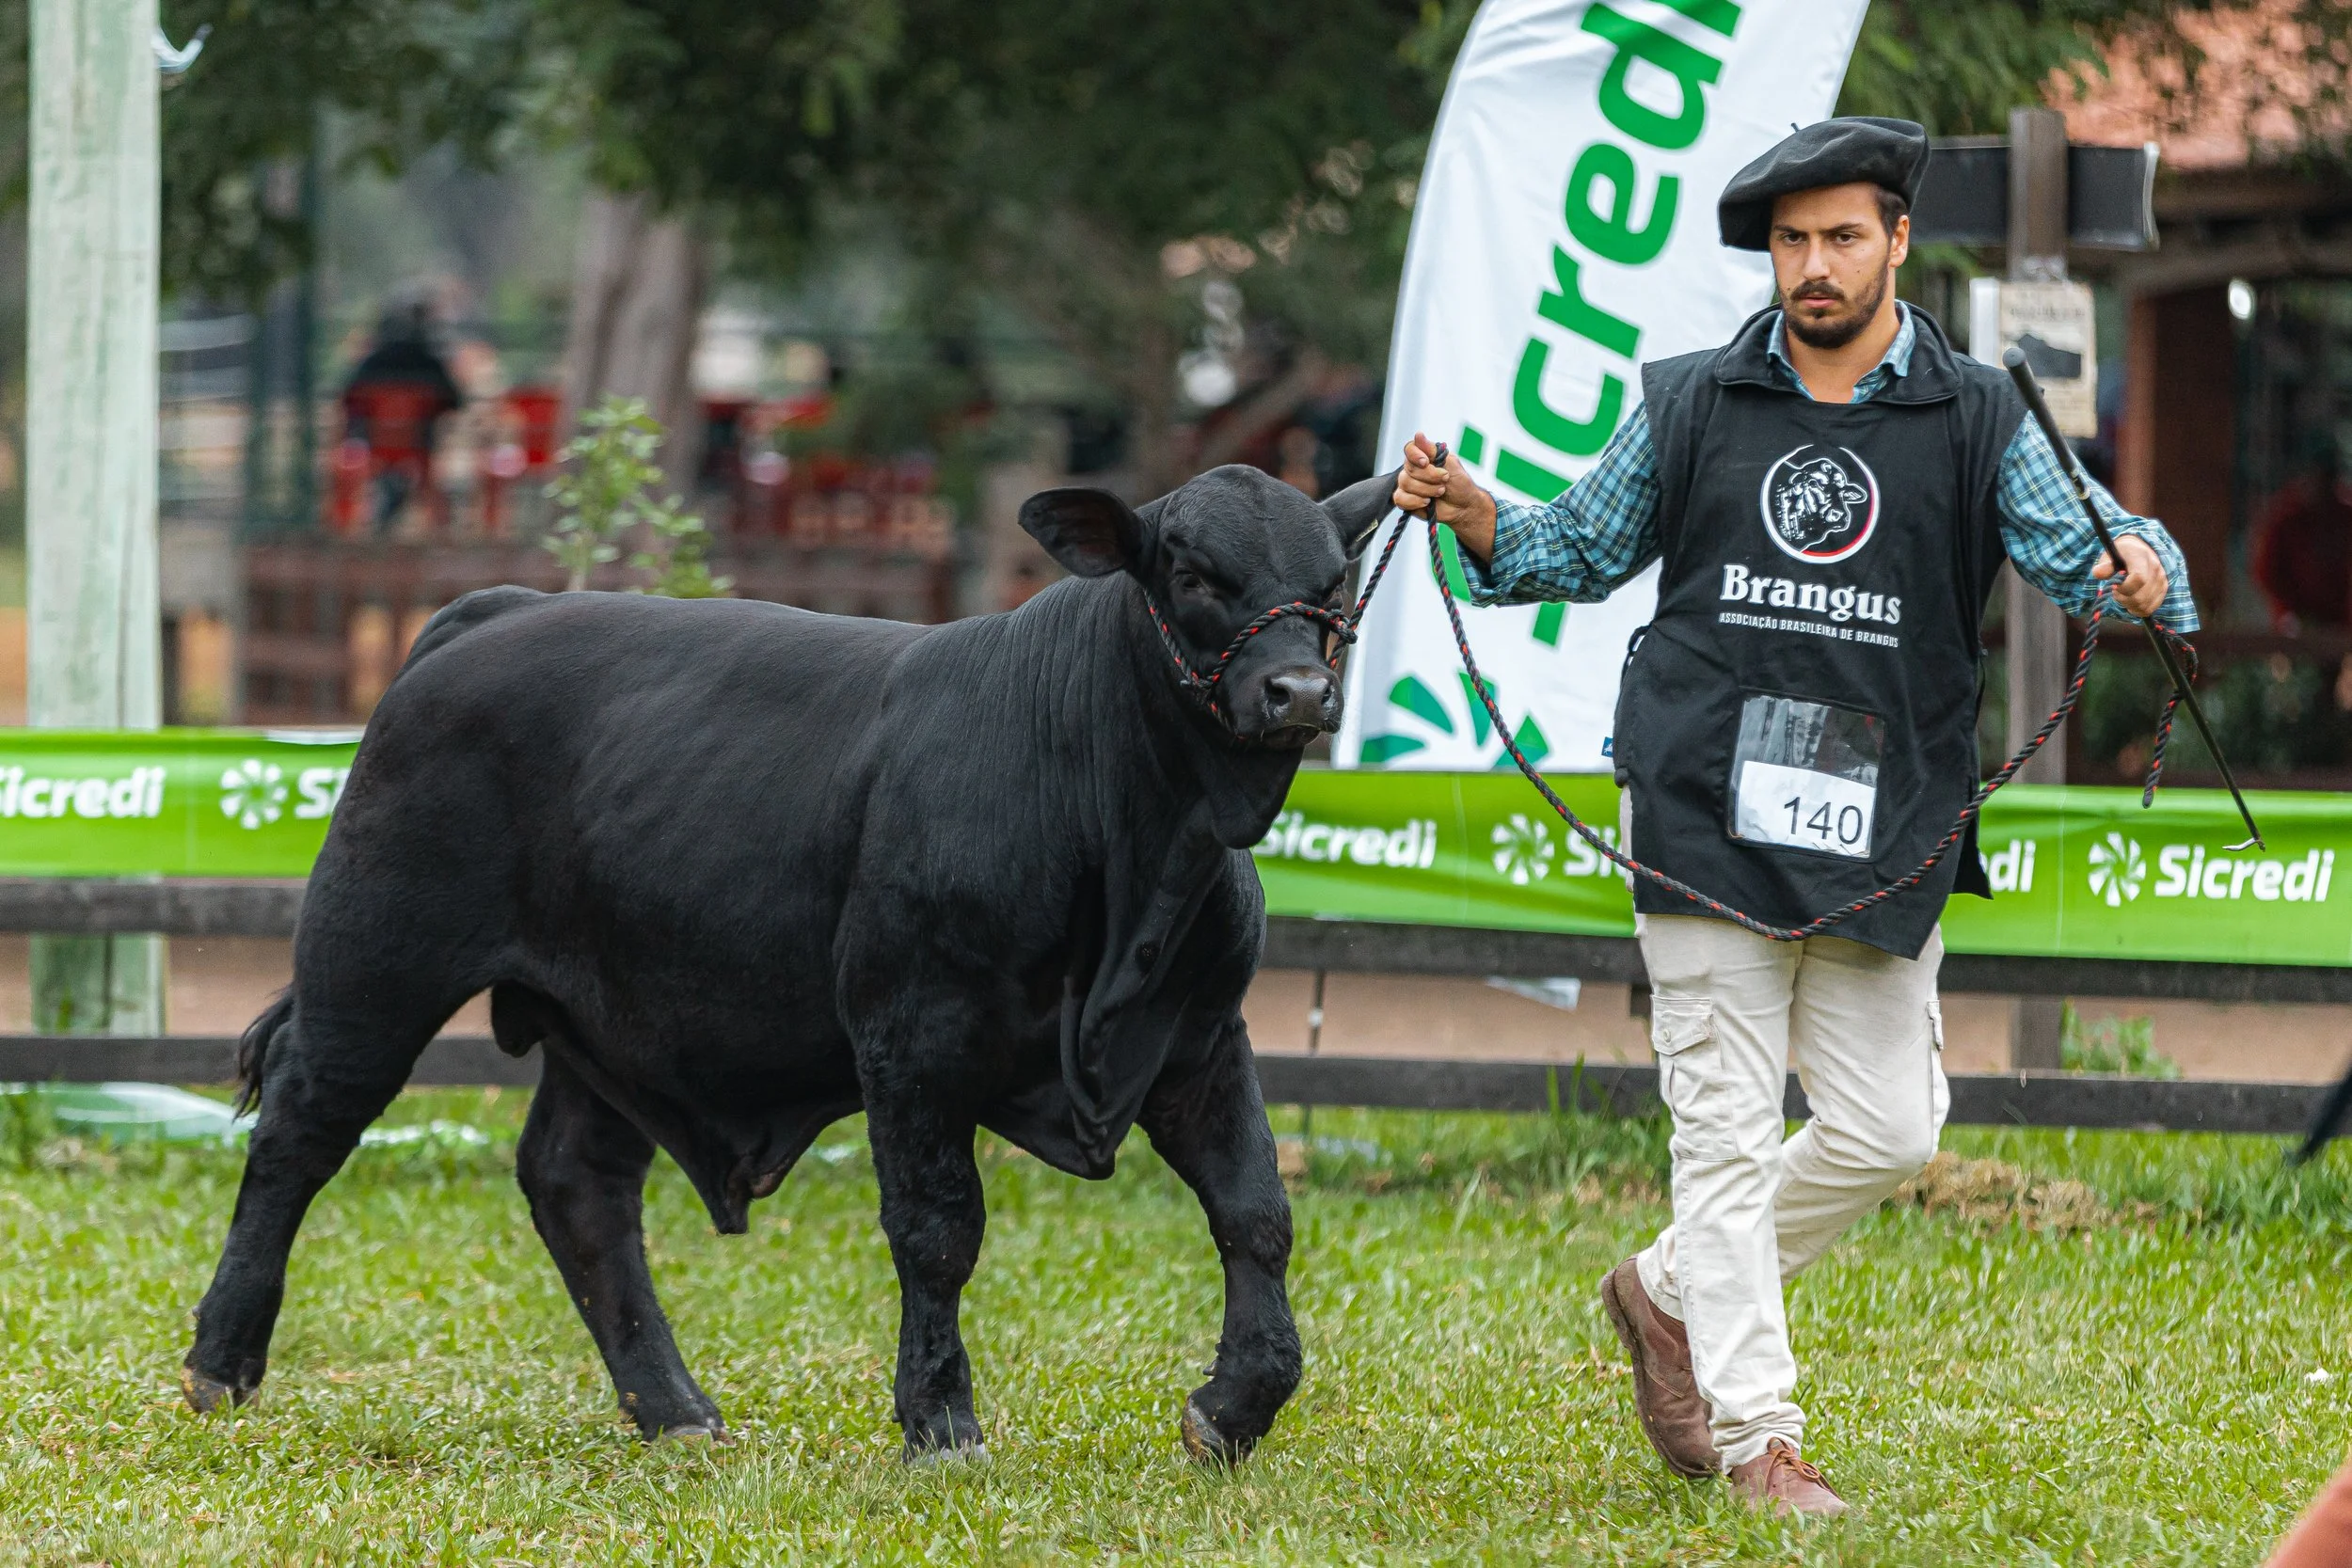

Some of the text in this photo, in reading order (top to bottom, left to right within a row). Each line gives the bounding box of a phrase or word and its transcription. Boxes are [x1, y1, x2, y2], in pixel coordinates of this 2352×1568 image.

[1720, 564, 1901, 625] Brangus
[1719, 612, 1899, 648] ASSOCIAÇÃO BRASILEIRA DE BRANGUS
[0, 766, 166, 818] icredi
[1783, 797, 1864, 845] 140
[2153, 844, 2335, 902] Sicredi
